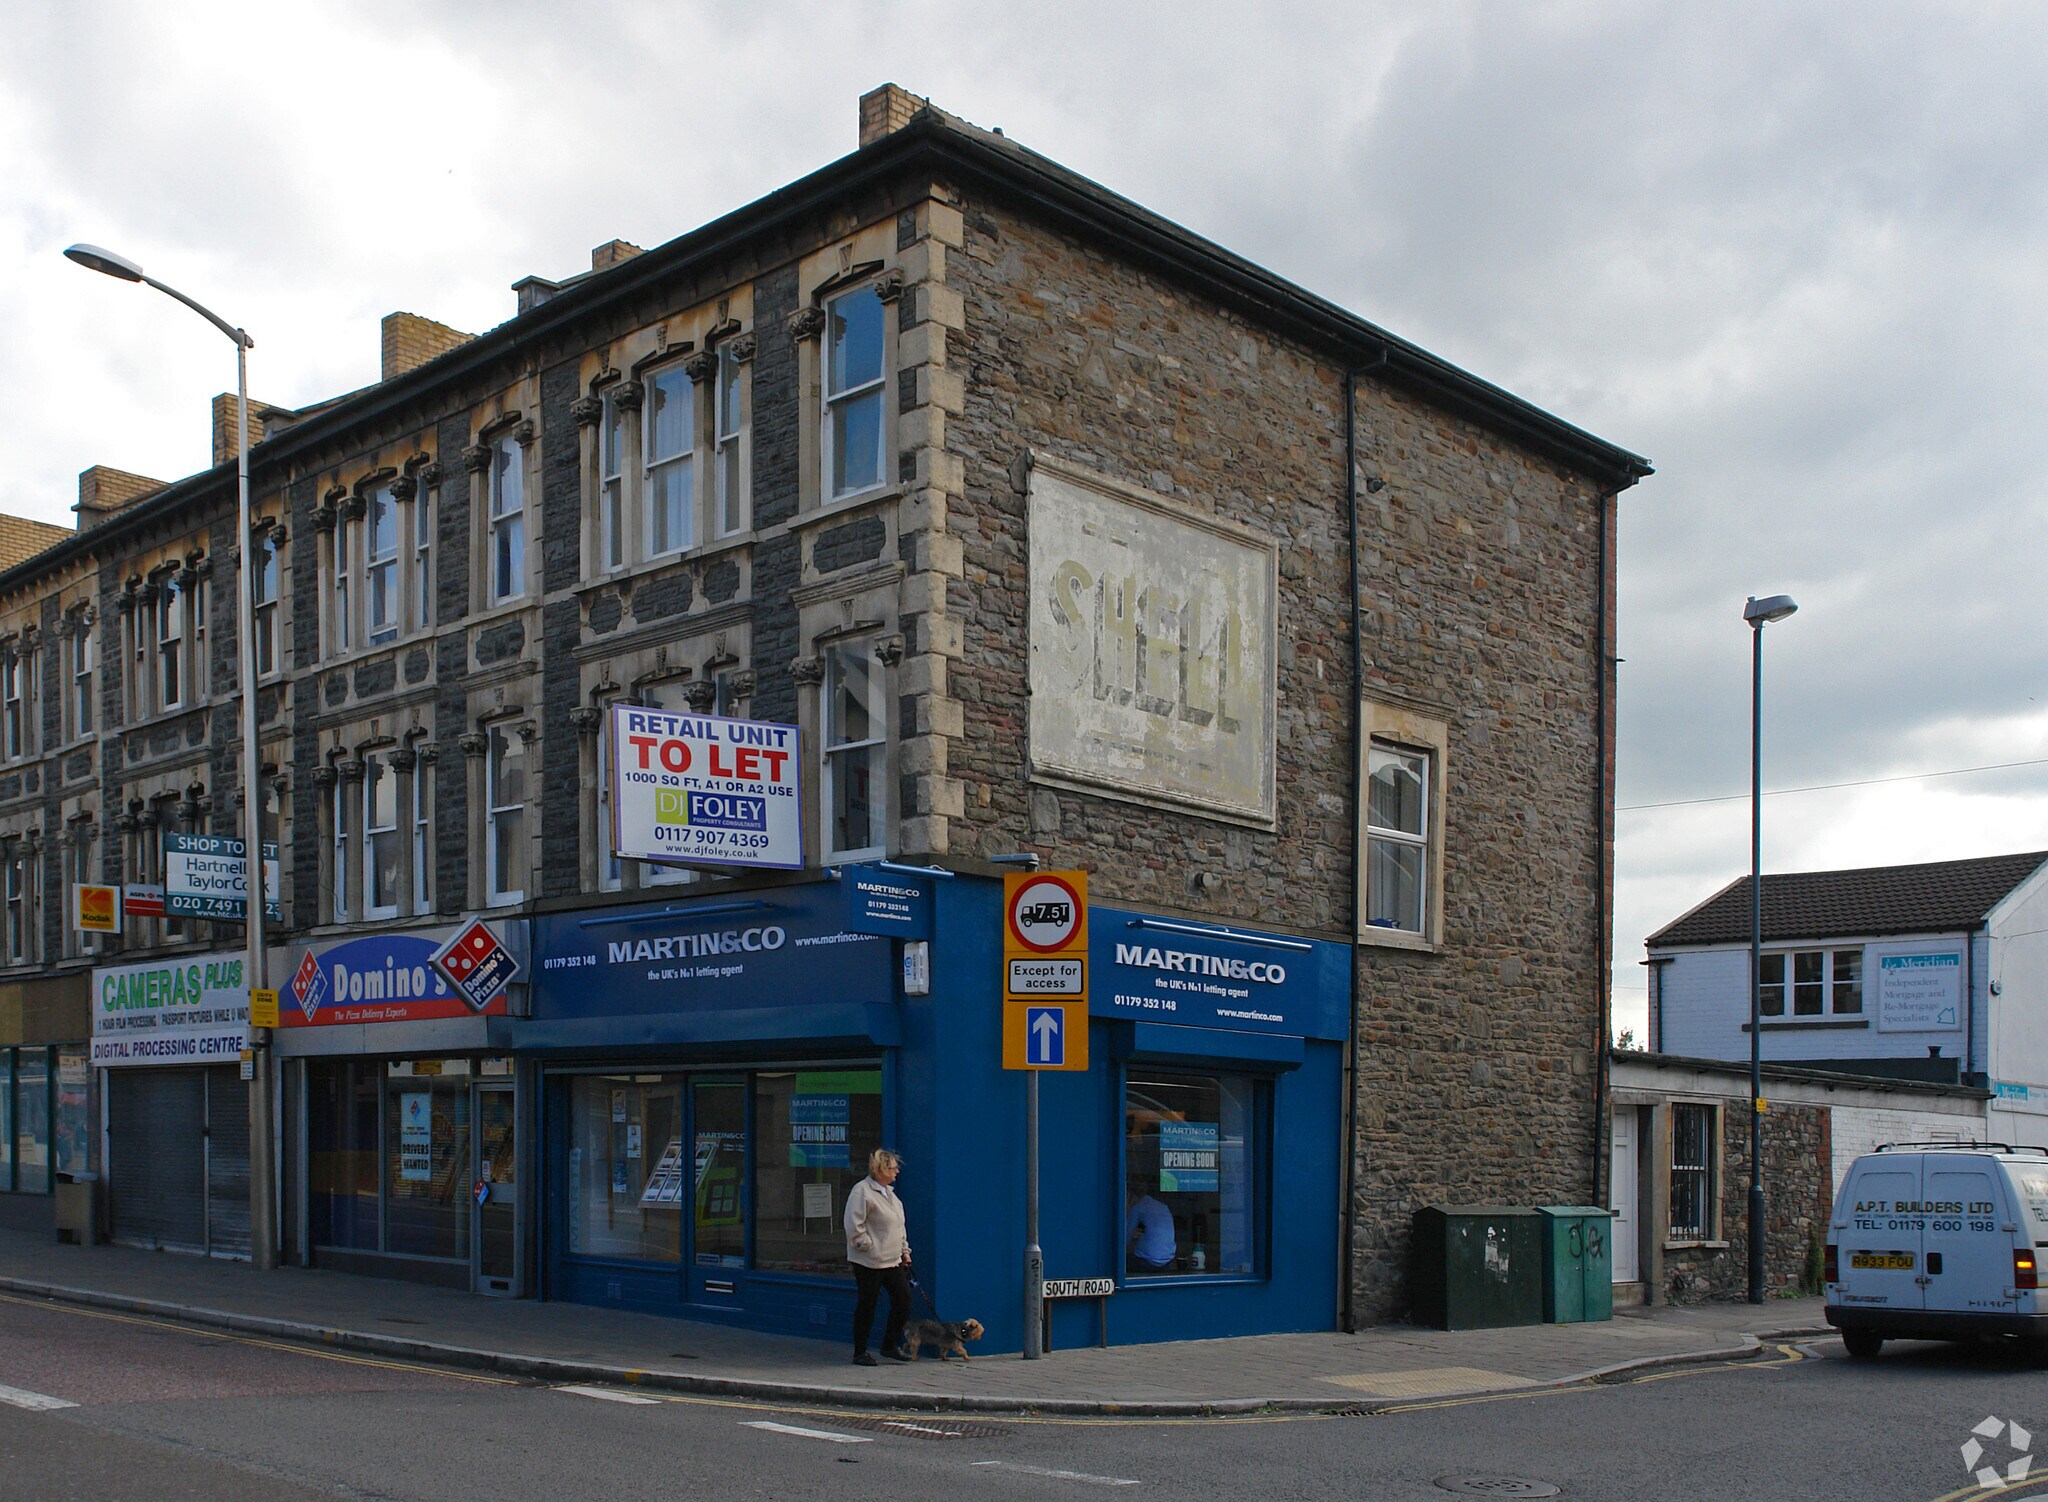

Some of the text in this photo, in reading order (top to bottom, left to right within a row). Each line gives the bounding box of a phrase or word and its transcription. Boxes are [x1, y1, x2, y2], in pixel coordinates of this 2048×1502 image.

[628, 713, 788, 748] RETAIL UNIT
[629, 735, 789, 783] TO LET
[625, 772, 793, 797] 1000 SQ FT, A1 OR A2 USE
[660, 792, 685, 816] DJ
[692, 795, 763, 821] FOLEY
[692, 816, 761, 829] PROPERTY CONSULTANTS
[178, 836, 219, 852] SHOP
[224, 840, 244, 854] TO
[655, 826, 769, 848] 0117 907 4369
[665, 844, 758, 858] www.djfoley.co.uk
[186, 857, 247, 874] Hartnell
[186, 873, 270, 893] Taylor Cok
[857, 882, 920, 897] MARTIN&CO
[173, 896, 201, 909] 020
[206, 899, 241, 912] 7491
[868, 900, 887, 909] 01179
[1037, 904, 1069, 919] 7.5T
[82, 913, 111, 923] Kodak
[608, 926, 786, 964] MARTIN&CO
[544, 954, 597, 970] 01179 352 148
[1115, 943, 1286, 985] MARTIN&CO
[1900, 957, 1955, 968] Meridian
[464, 951, 505, 993] Domino's
[647, 971, 660, 981] the
[661, 969, 679, 979] UK's
[696, 966, 720, 979] letting
[721, 964, 743, 977] agent
[1014, 965, 1077, 977] Except for
[102, 959, 244, 1012] CAMERAS PLUS
[302, 972, 323, 1010] Domino's
[472, 977, 500, 1004] Pizza
[1025, 978, 1066, 988] access
[1155, 977, 1168, 989] the
[1169, 978, 1187, 990] UK's
[1203, 982, 1226, 997] letting
[1228, 984, 1249, 998] agent
[1884, 978, 1938, 988] Independent
[1884, 988, 1945, 999] Mortgage and
[306, 994, 320, 1018] Pizza
[1114, 995, 1177, 1011] 01179 352 148
[1884, 1002, 1940, 1011] Re-Mortgage
[102, 1017, 115, 1030] HOUR
[116, 1016, 127, 1029] FILM
[127, 1014, 157, 1029] PROCESSING
[162, 1011, 187, 1026] PASSPORT
[188, 1009, 213, 1024] PICTURES
[214, 1008, 230, 1022] WHILE
[334, 1011, 344, 1021] The
[362, 1009, 384, 1020] Delivery
[385, 1007, 408, 1019] Experts
[1216, 1007, 1284, 1023] www.martinco.com
[1883, 1014, 1929, 1023] Specialists
[94, 1036, 243, 1059] DIGITAL PROCESSING CENTRE
[792, 1099, 847, 1107] MARTIN&CO
[792, 1125, 825, 1141] OPENING
[825, 1125, 846, 1142] SOON
[1163, 1127, 1216, 1136] MARTIN&CO
[402, 1143, 429, 1155] DRIVERS
[402, 1158, 429, 1170] WANTED
[1163, 1152, 1215, 1168] OPENING SOON
[1855, 1201, 1994, 1214] A.P.T. BUILDERS LTD
[1854, 1219, 1994, 1232] TEL: 01179 600 198
[1852, 1256, 1914, 1268] R933 FOU
[1045, 1280, 1111, 1296] SOUTH ROAD
